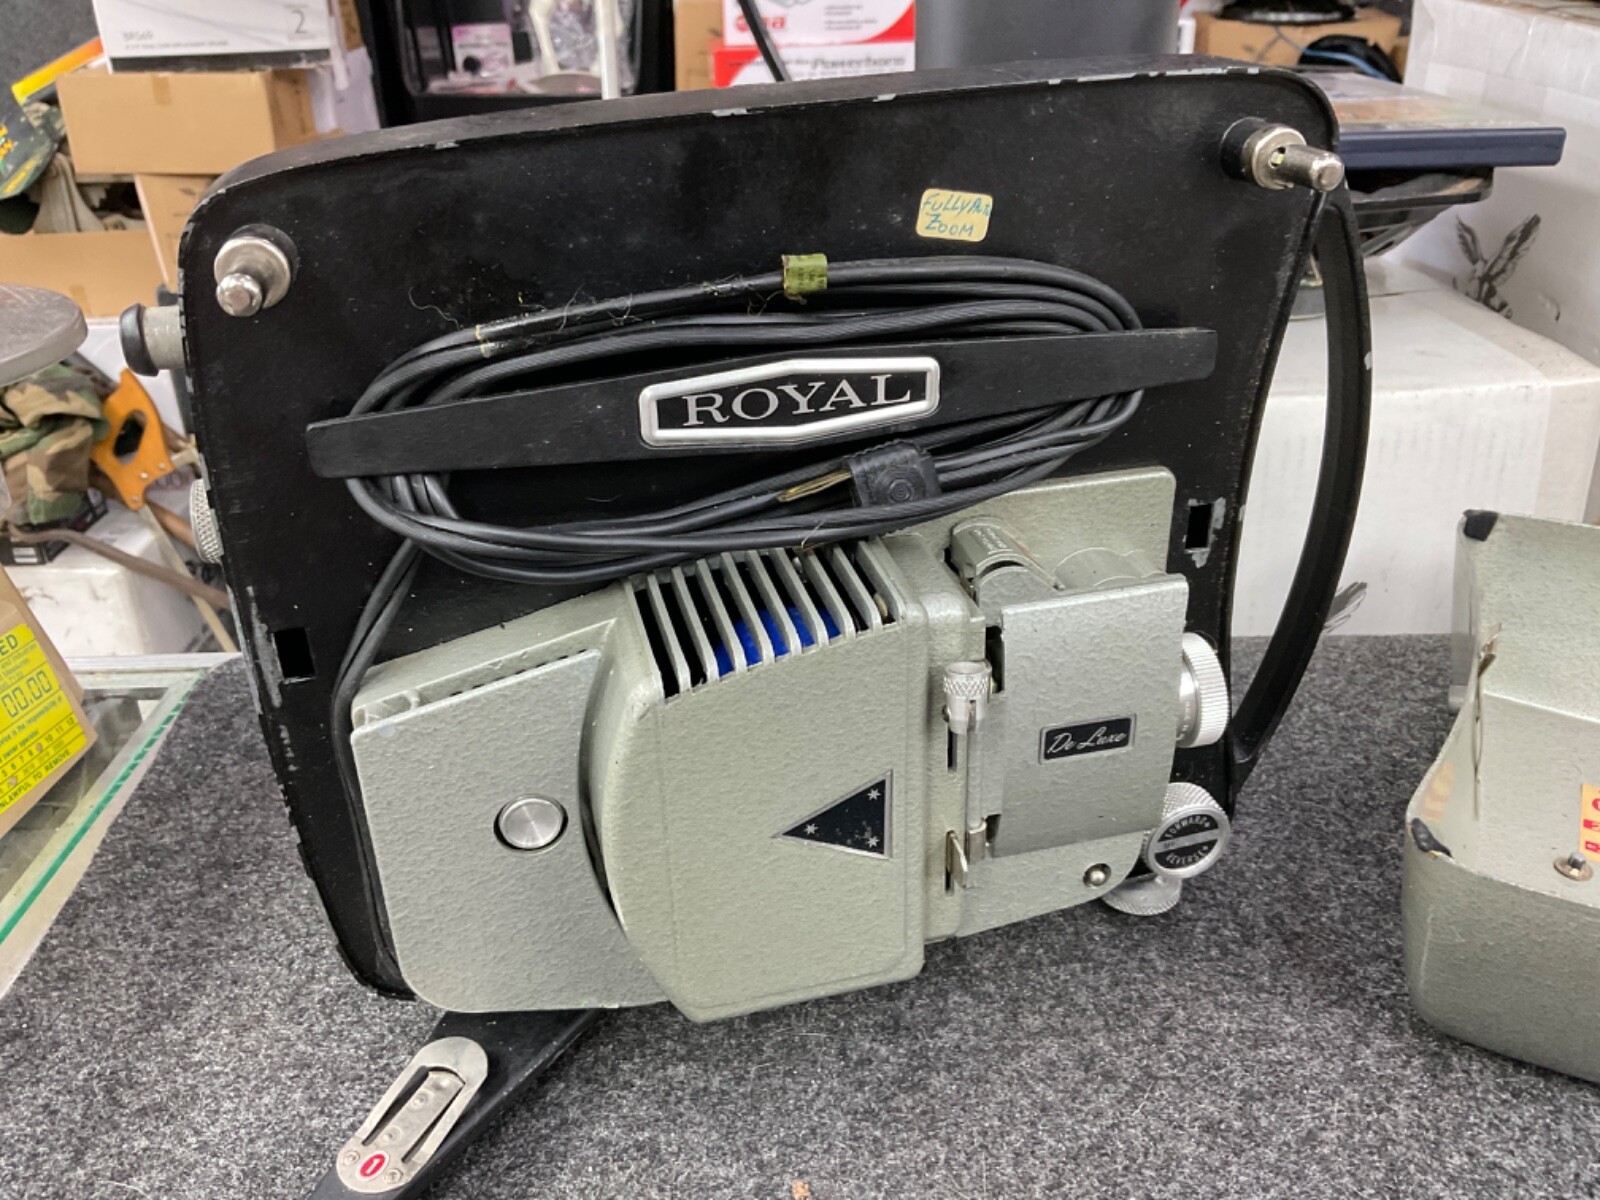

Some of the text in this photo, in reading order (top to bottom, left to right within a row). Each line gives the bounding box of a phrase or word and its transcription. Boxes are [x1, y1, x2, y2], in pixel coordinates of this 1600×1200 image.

[291, 9, 308, 35] 2
[682, 374, 911, 427] ROYAL
[1, 669, 52, 719] 00.00
[1046, 726, 1127, 755] De Luxe
